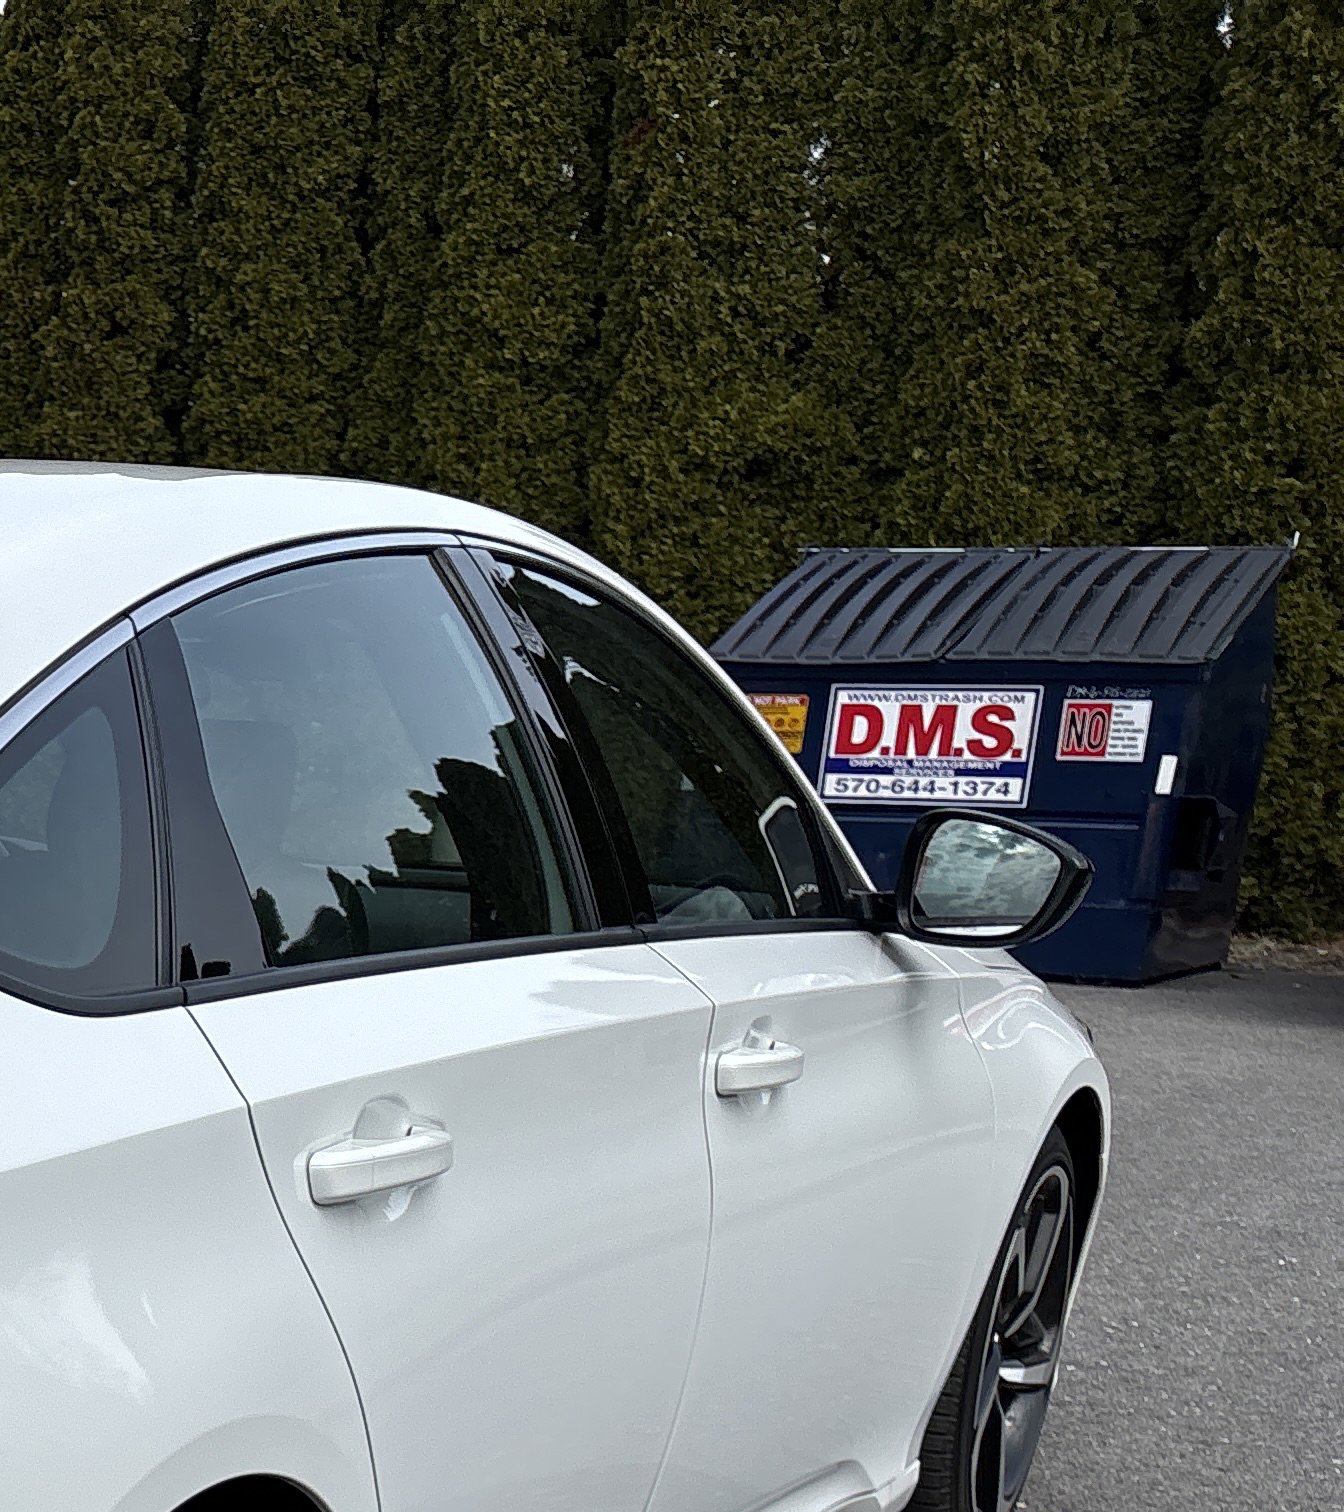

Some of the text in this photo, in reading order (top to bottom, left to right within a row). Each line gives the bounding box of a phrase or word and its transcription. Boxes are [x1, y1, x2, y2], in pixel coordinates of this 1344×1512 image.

[847, 692, 1026, 705] WWW.DMSTRASH.COM
[834, 703, 1022, 759] D.M.S.
[1063, 706, 1109, 753] NO
[833, 776, 1012, 798] 570-644-1374
